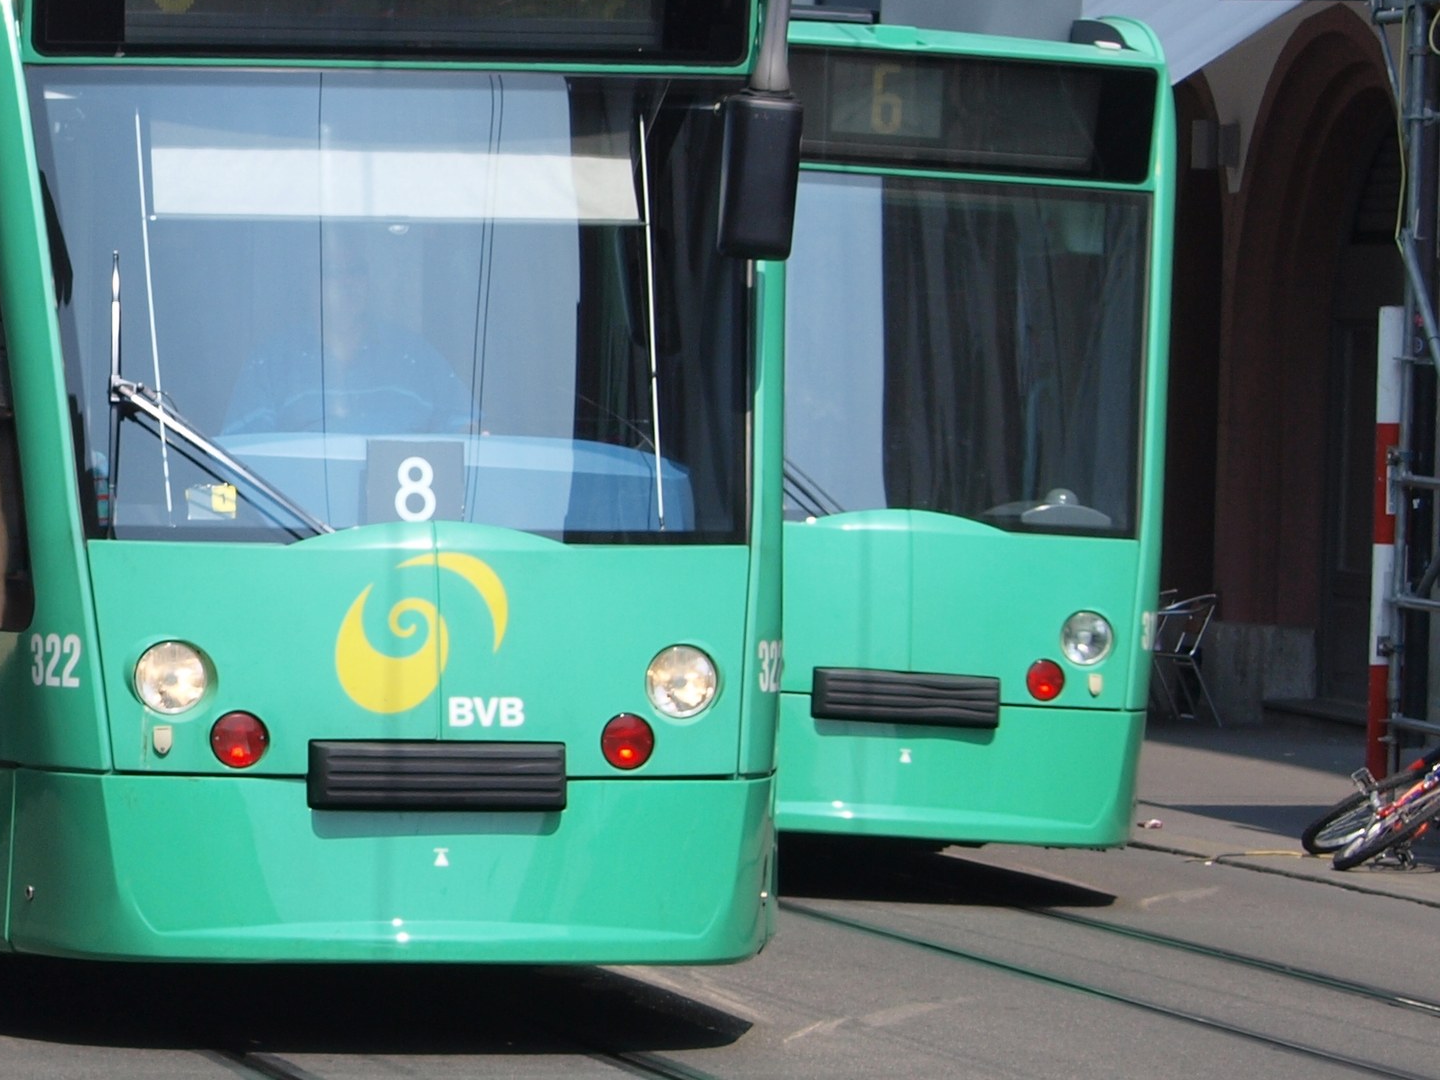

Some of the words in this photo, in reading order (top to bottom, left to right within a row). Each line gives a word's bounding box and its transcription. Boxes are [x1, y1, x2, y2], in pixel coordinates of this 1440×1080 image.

[871, 63, 903, 133] 6
[394, 457, 436, 522] 8
[30, 633, 82, 689] 322
[448, 696, 525, 727] BVB
